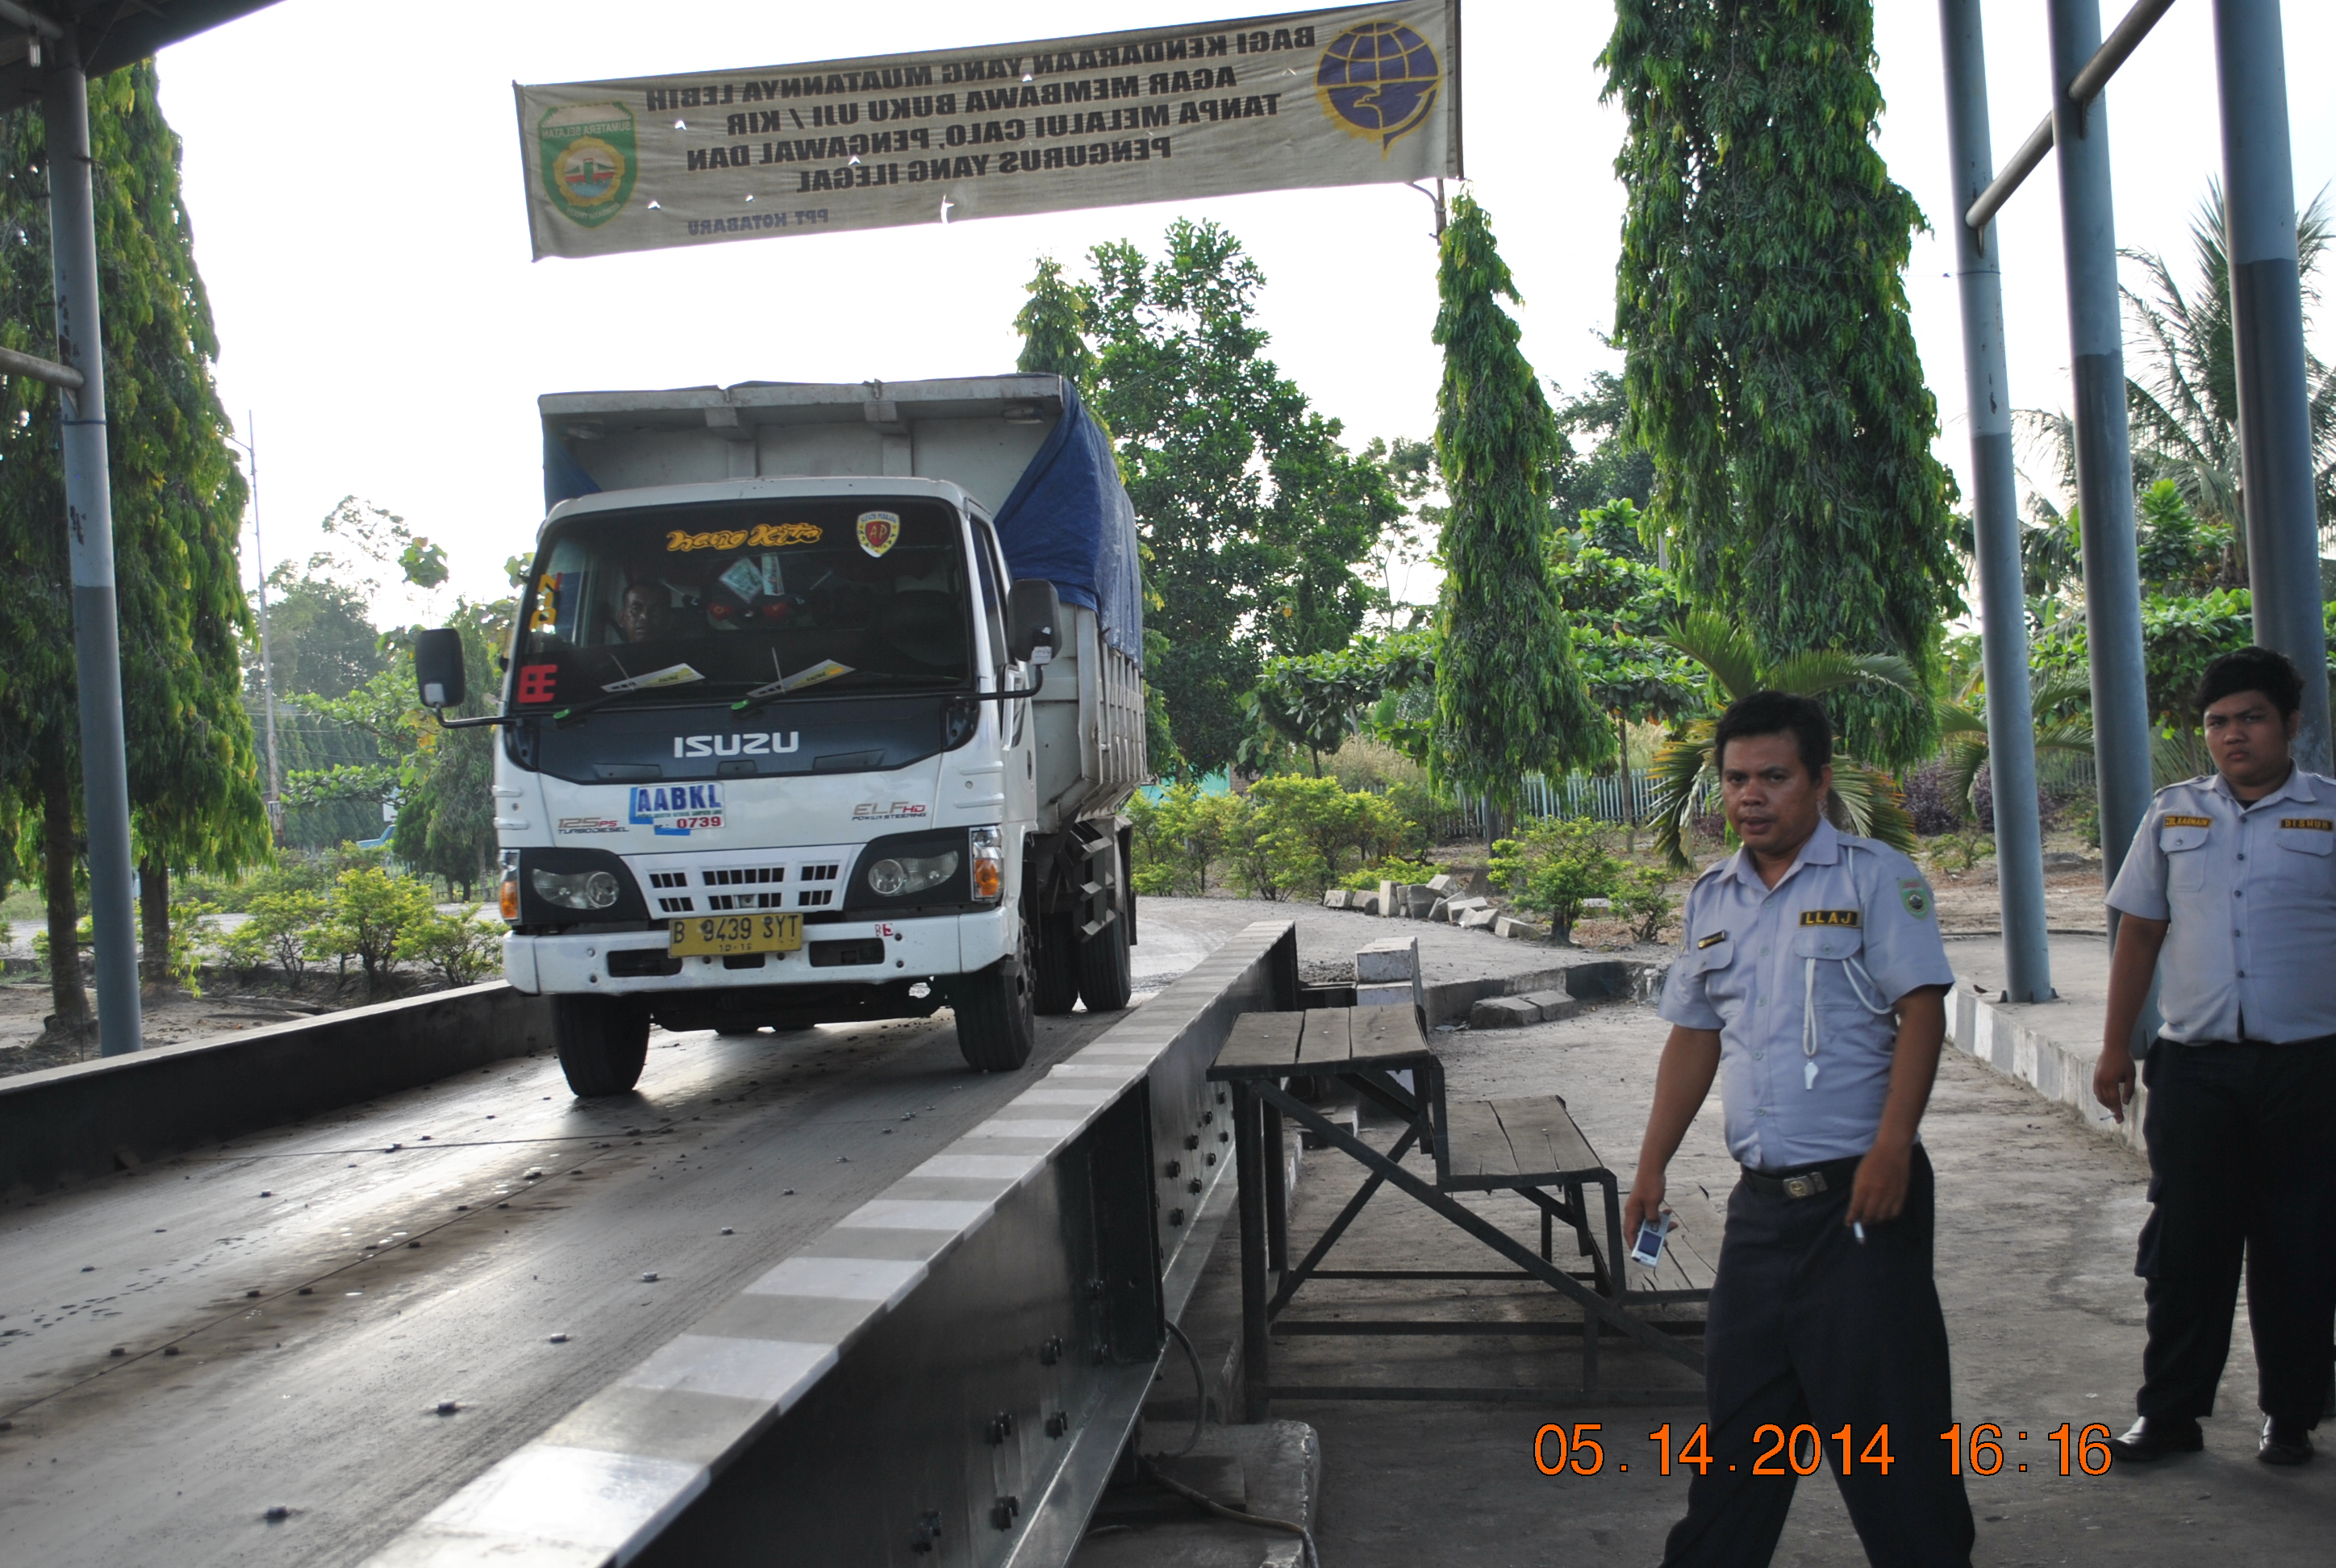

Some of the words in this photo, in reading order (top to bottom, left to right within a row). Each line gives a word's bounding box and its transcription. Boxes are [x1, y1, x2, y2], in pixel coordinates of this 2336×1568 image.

[674, 732, 799, 757] ISUZU
[637, 785, 722, 812] AABKL
[676, 816, 722, 828] 0739
[673, 921, 685, 945] B
[700, 916, 752, 942] 9439
[762, 915, 799, 939] SYT
[1805, 911, 1853, 925] LLAJ
